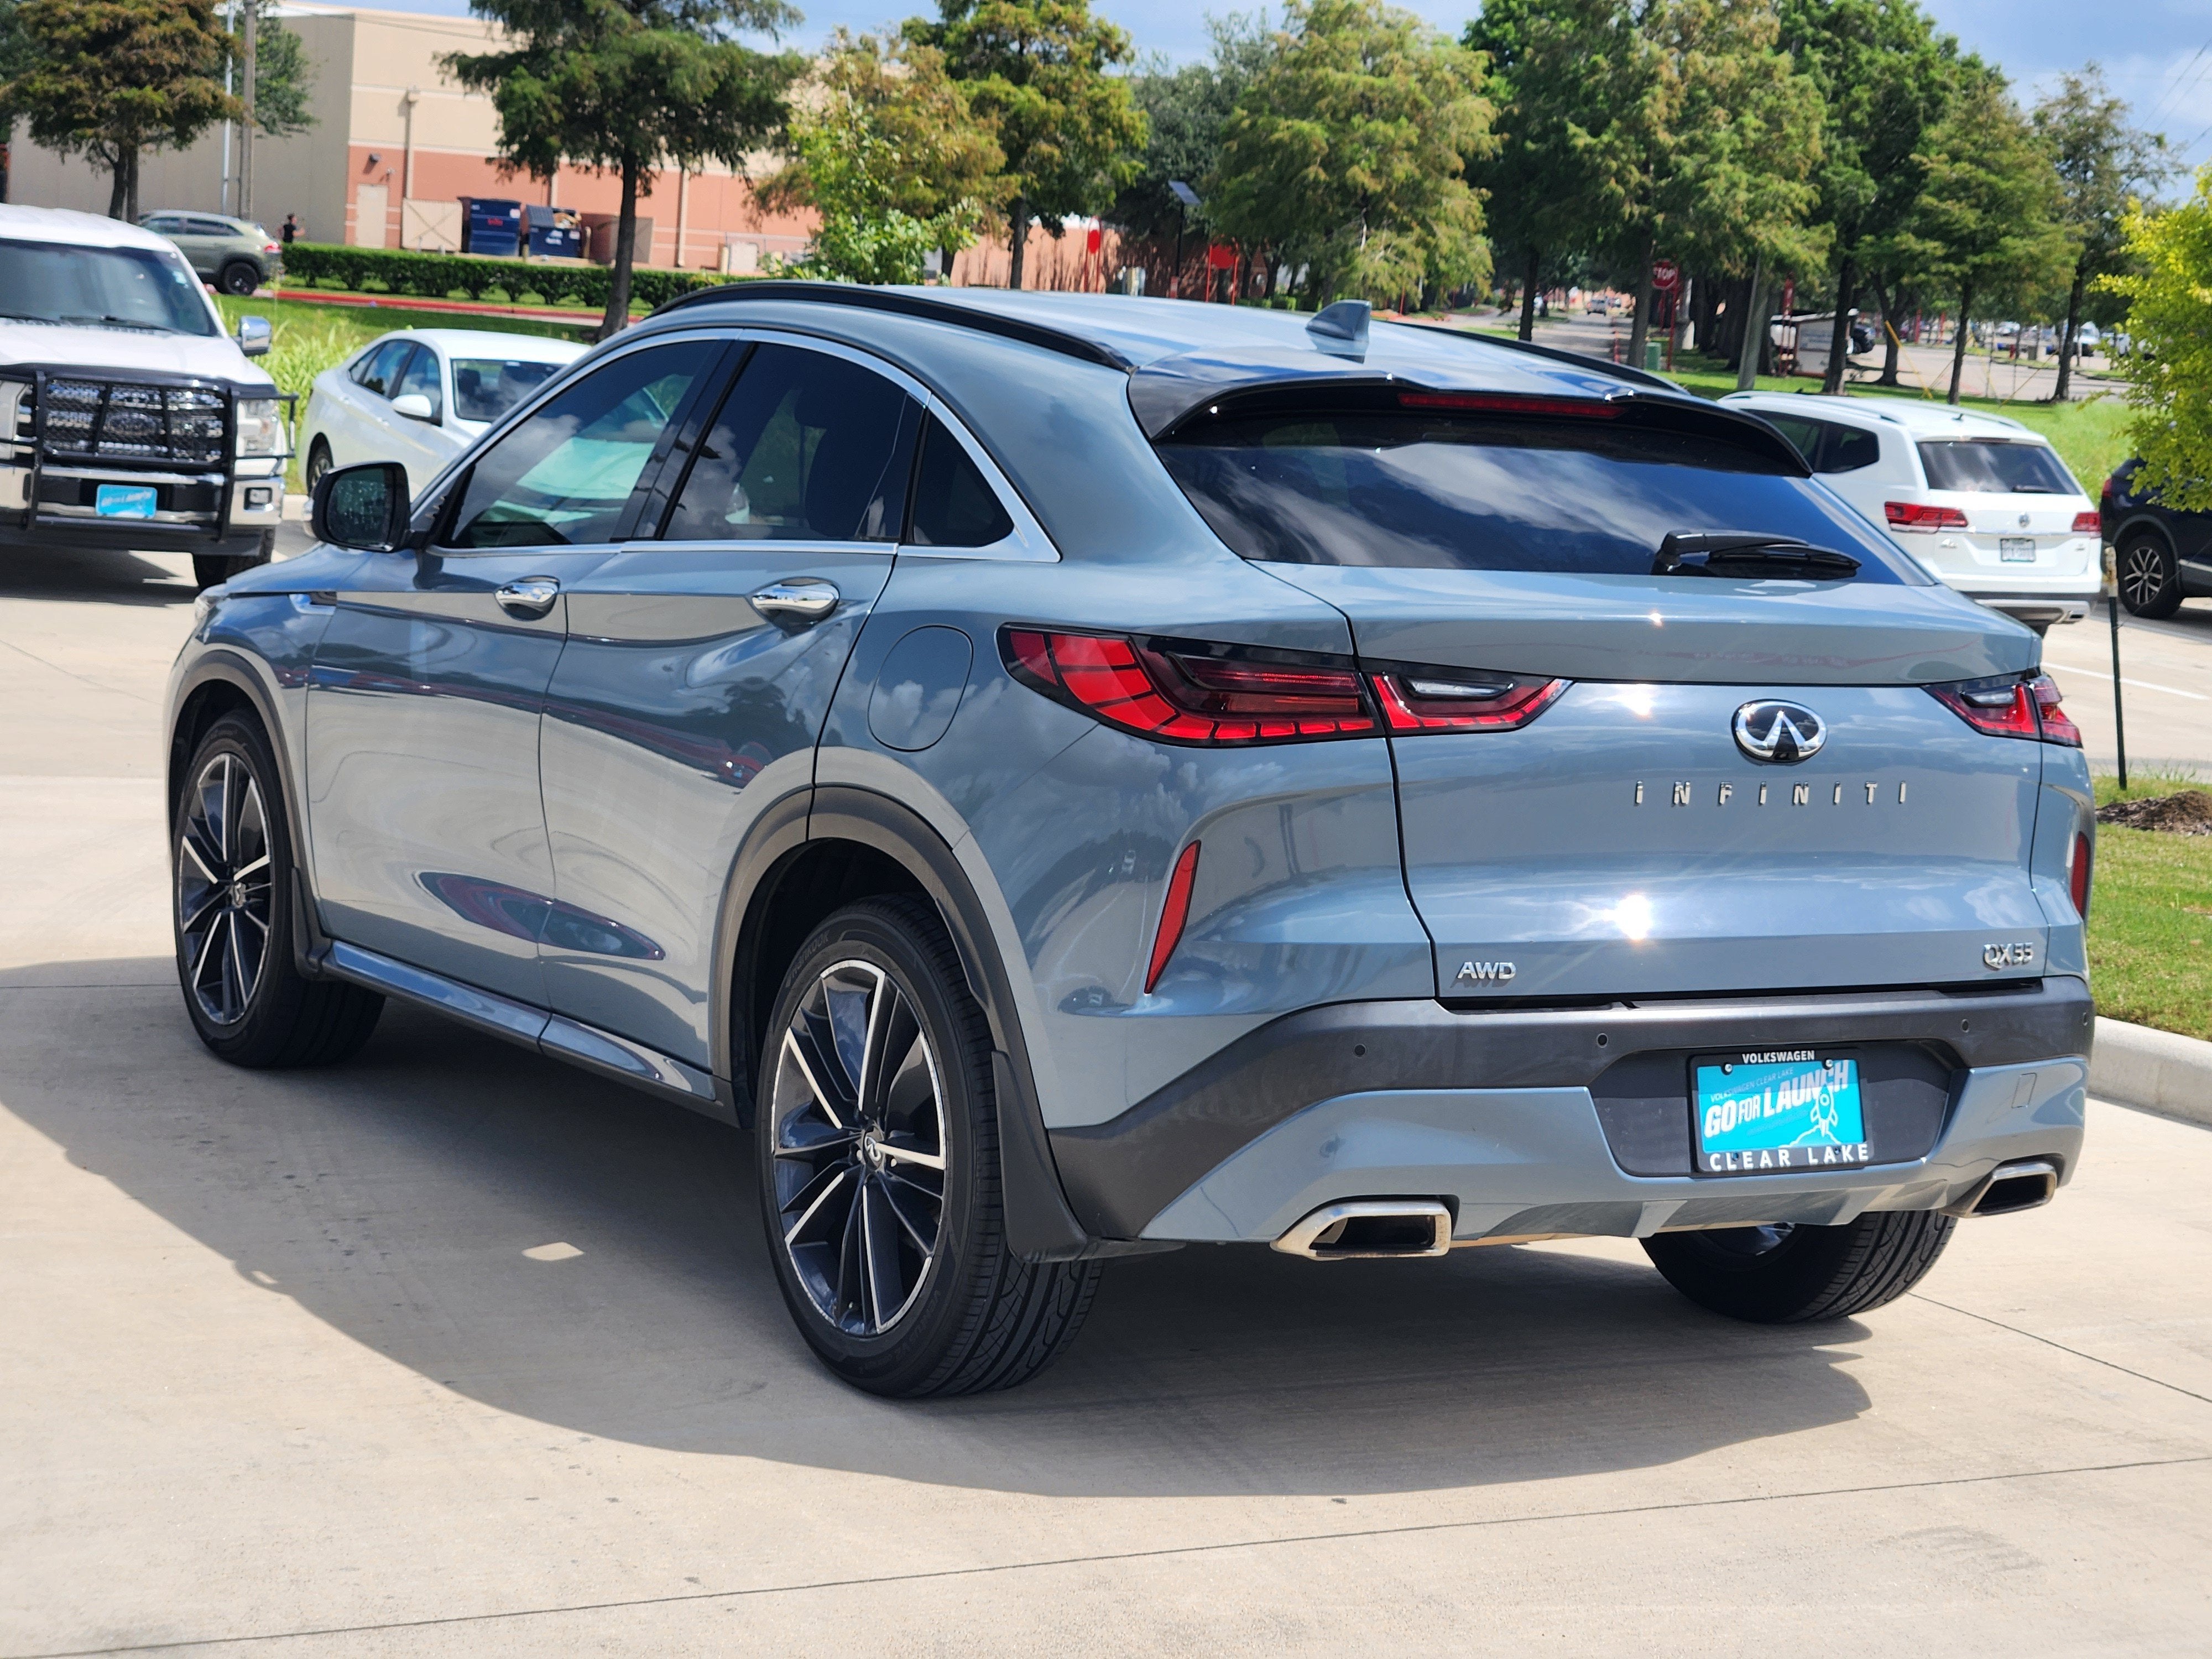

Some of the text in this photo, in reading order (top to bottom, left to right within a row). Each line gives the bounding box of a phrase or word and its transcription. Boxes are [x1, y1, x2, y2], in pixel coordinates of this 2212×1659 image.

[1653, 267, 1676, 280] STOP
[1635, 780, 1907, 805] INFINITI
[1983, 942, 2034, 969] QX55
[1457, 961, 1516, 979] AWD
[1742, 1051, 1815, 1064] VOLKSWAGEN
[1710, 1067, 1794, 1103] VOLKSWAGEN CLEAR LAKE
[1704, 1099, 1736, 1138] GO
[1738, 1094, 1761, 1124] FOR
[1763, 1060, 1849, 1118] LAUNCH
[1709, 1144, 1869, 1172] CLEAR LAKE
